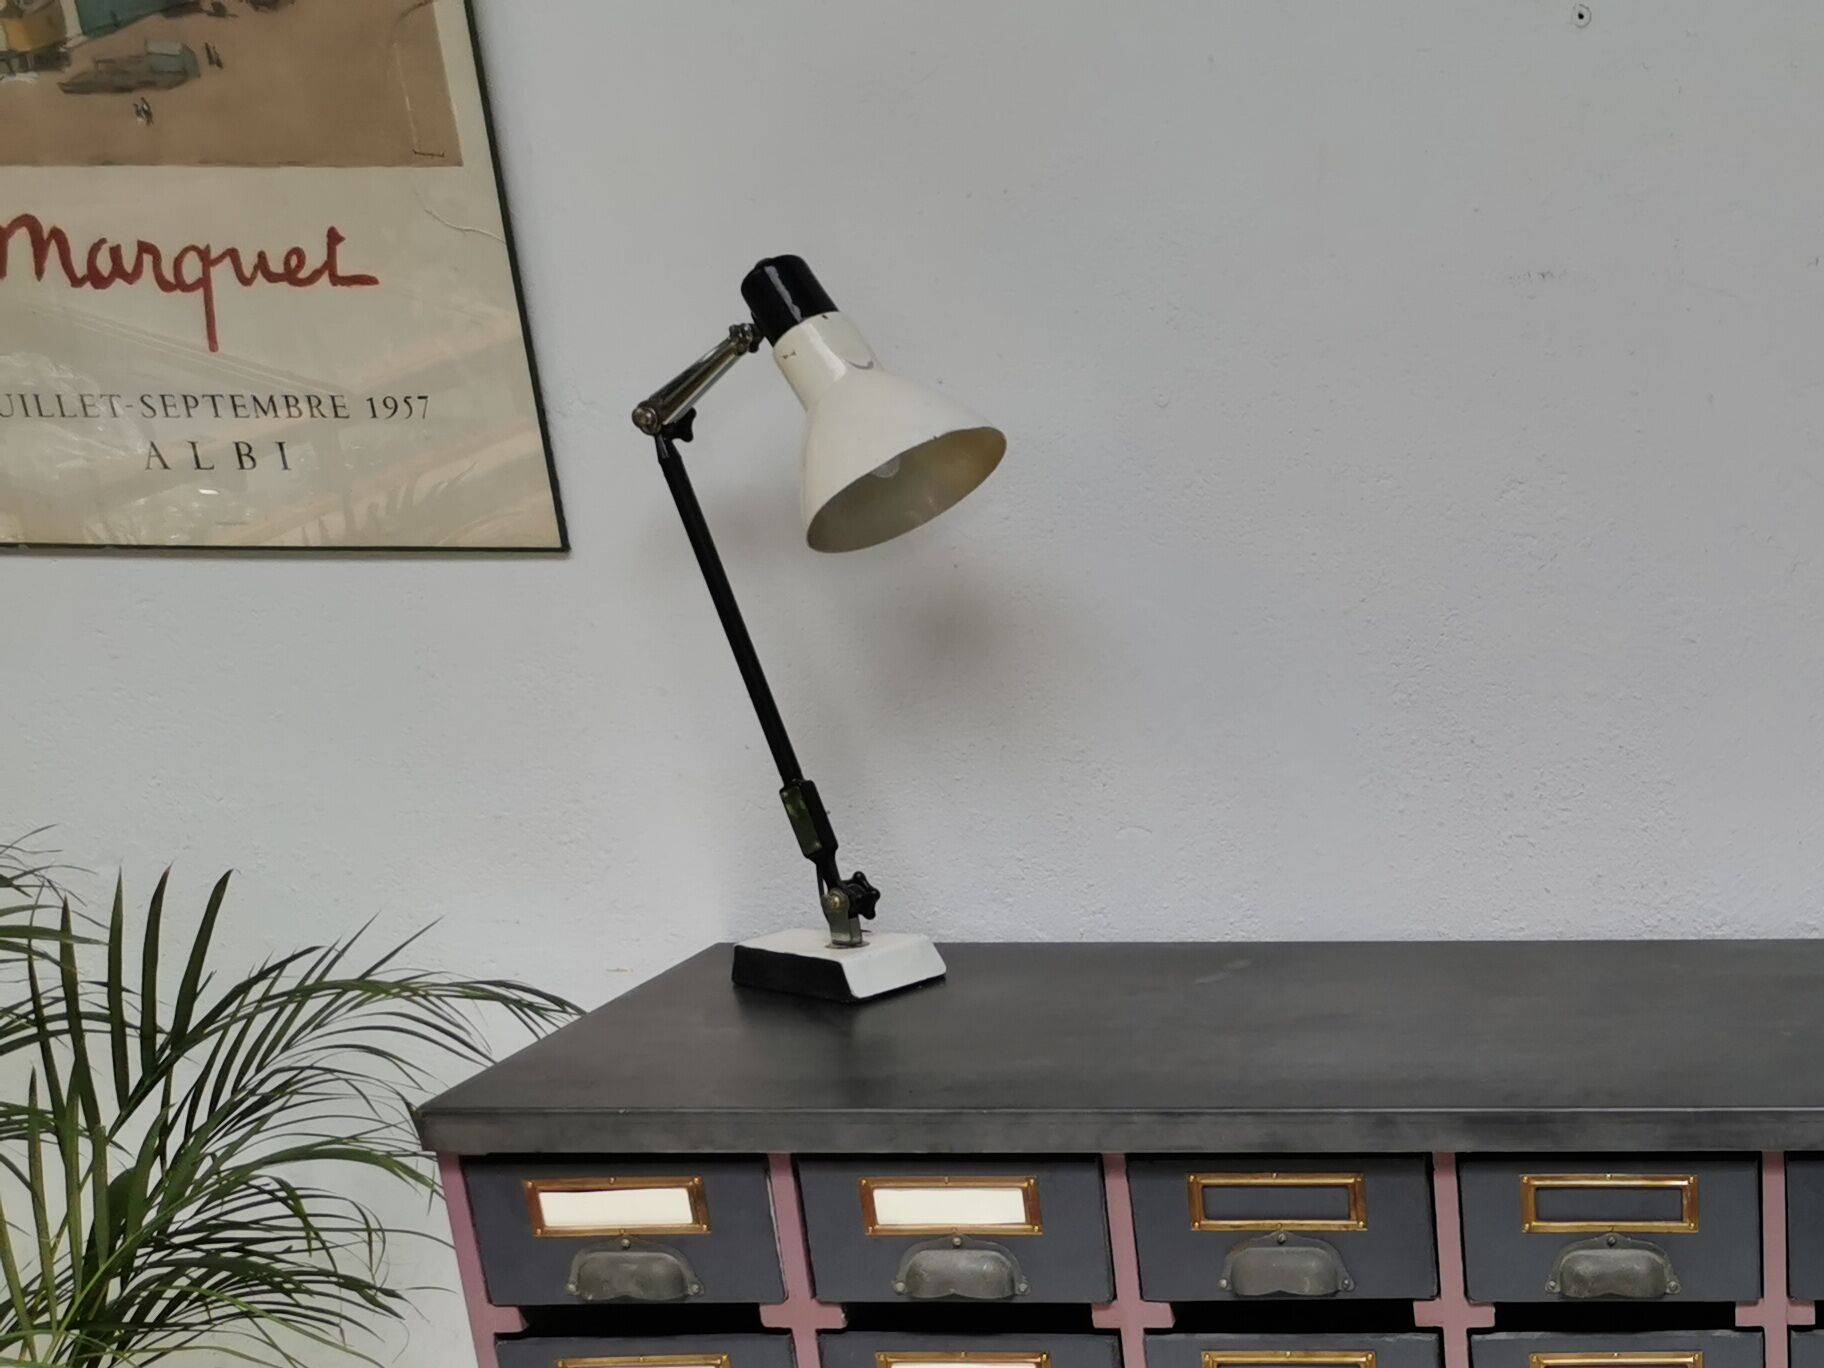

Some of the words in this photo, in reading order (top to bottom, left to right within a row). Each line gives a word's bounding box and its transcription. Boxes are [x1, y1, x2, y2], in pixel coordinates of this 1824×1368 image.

[0, 213, 380, 353] Marquet
[366, 395, 429, 420] 1957
[145, 440, 292, 471] ALBI
